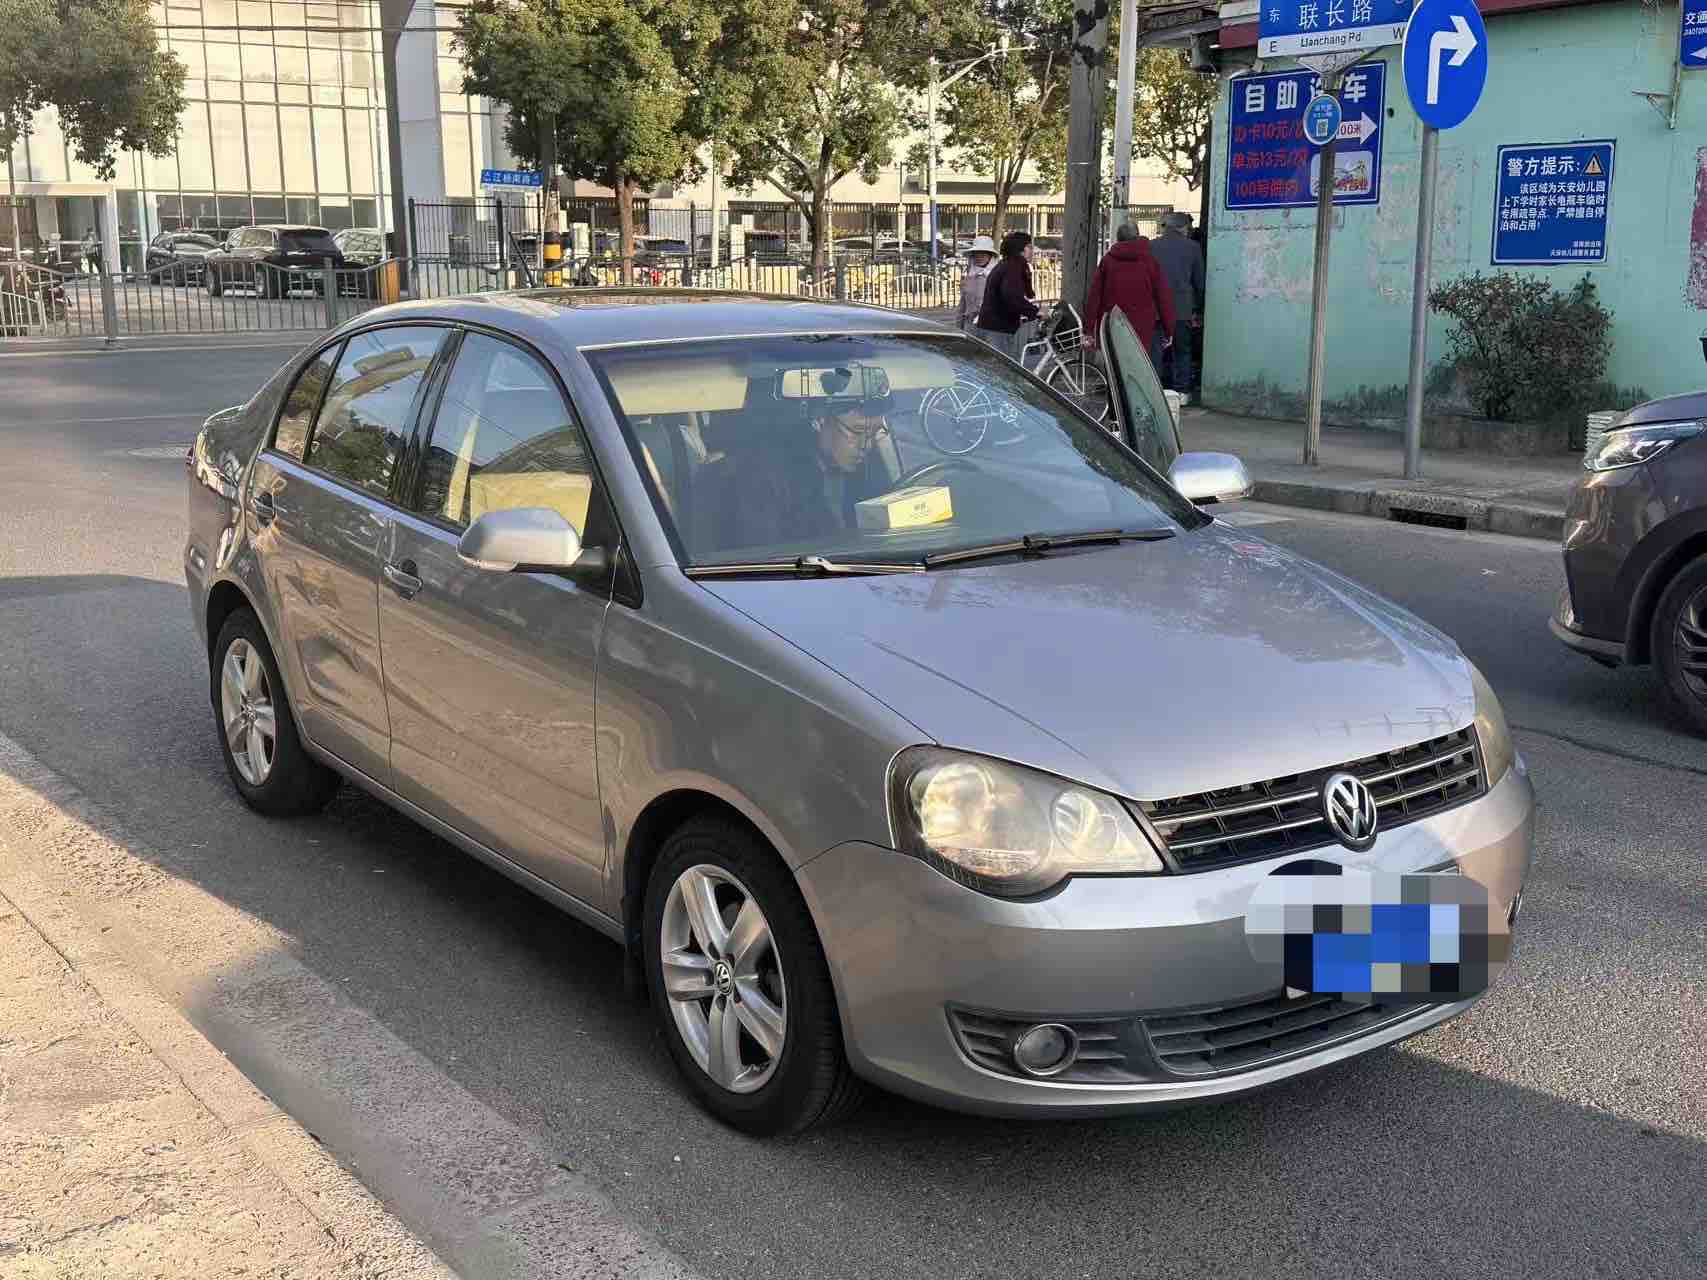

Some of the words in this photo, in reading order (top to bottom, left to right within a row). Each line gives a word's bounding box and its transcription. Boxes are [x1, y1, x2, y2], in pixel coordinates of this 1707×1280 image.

[1269, 8, 1280, 23] 东
[1298, 0, 1372, 29] 联长路
[1269, 41, 1277, 53] E
[1350, 32, 1361, 43] Rd
[1393, 26, 1405, 40] W
[1338, 123, 1361, 136] 00米
[1520, 180, 1605, 194] 该区域为天安幼儿园
[1503, 193, 1605, 208] 上下学时家长电瓶车临时
